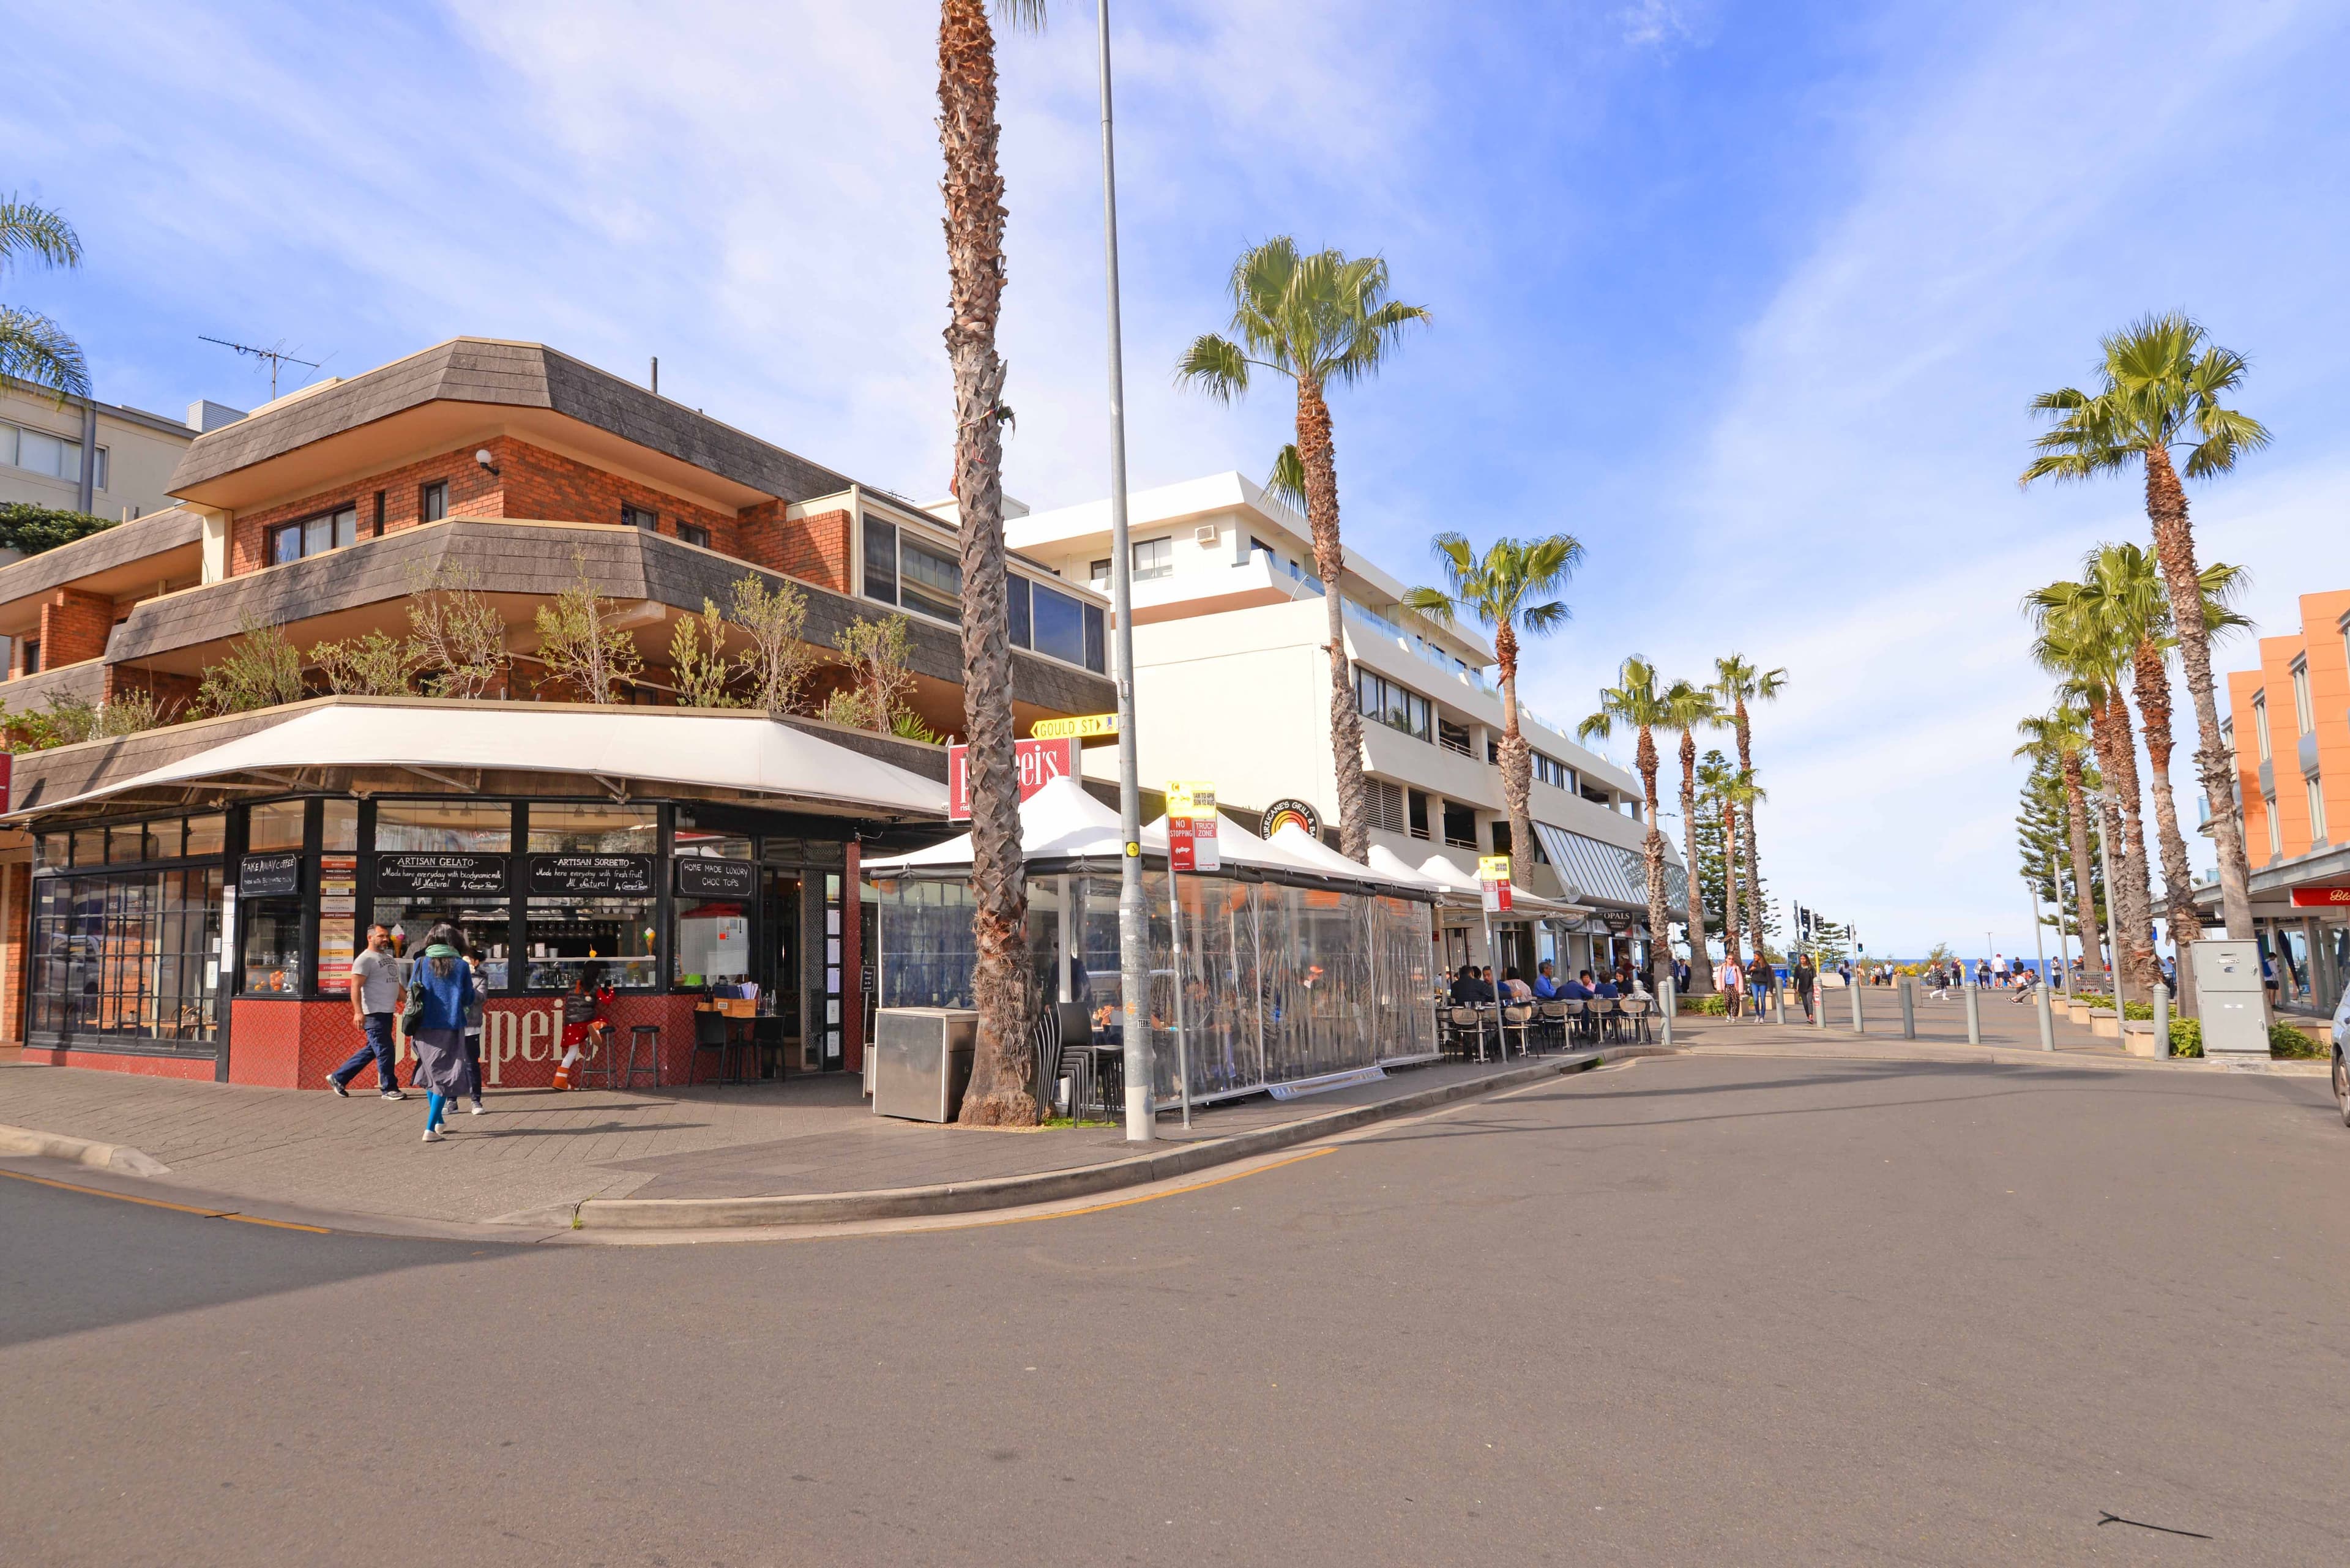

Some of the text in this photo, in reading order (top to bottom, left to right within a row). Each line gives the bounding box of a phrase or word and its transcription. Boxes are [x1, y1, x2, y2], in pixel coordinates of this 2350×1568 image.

[1040, 719, 1094, 736] GOULD ST
[1292, 802, 1309, 817] GRILL
[1176, 819, 1185, 828] NO
[244, 859, 294, 872] TAKE AWAY COFFEE
[397, 857, 474, 866] ARTISAN GELATO
[382, 867, 401, 876] Made
[403, 868, 415, 877] here
[417, 870, 446, 880] everyday
[460, 869, 491, 879] biodynamic
[491, 870, 501, 879] milk
[536, 868, 643, 879] Made here everyday with fresh fruit
[726, 867, 748, 878] LUXURY
[412, 877, 422, 887] All
[423, 878, 450, 887] Natural
[566, 878, 575, 887] All
[580, 878, 609, 887] Natural
[702, 877, 720, 886] CHOC
